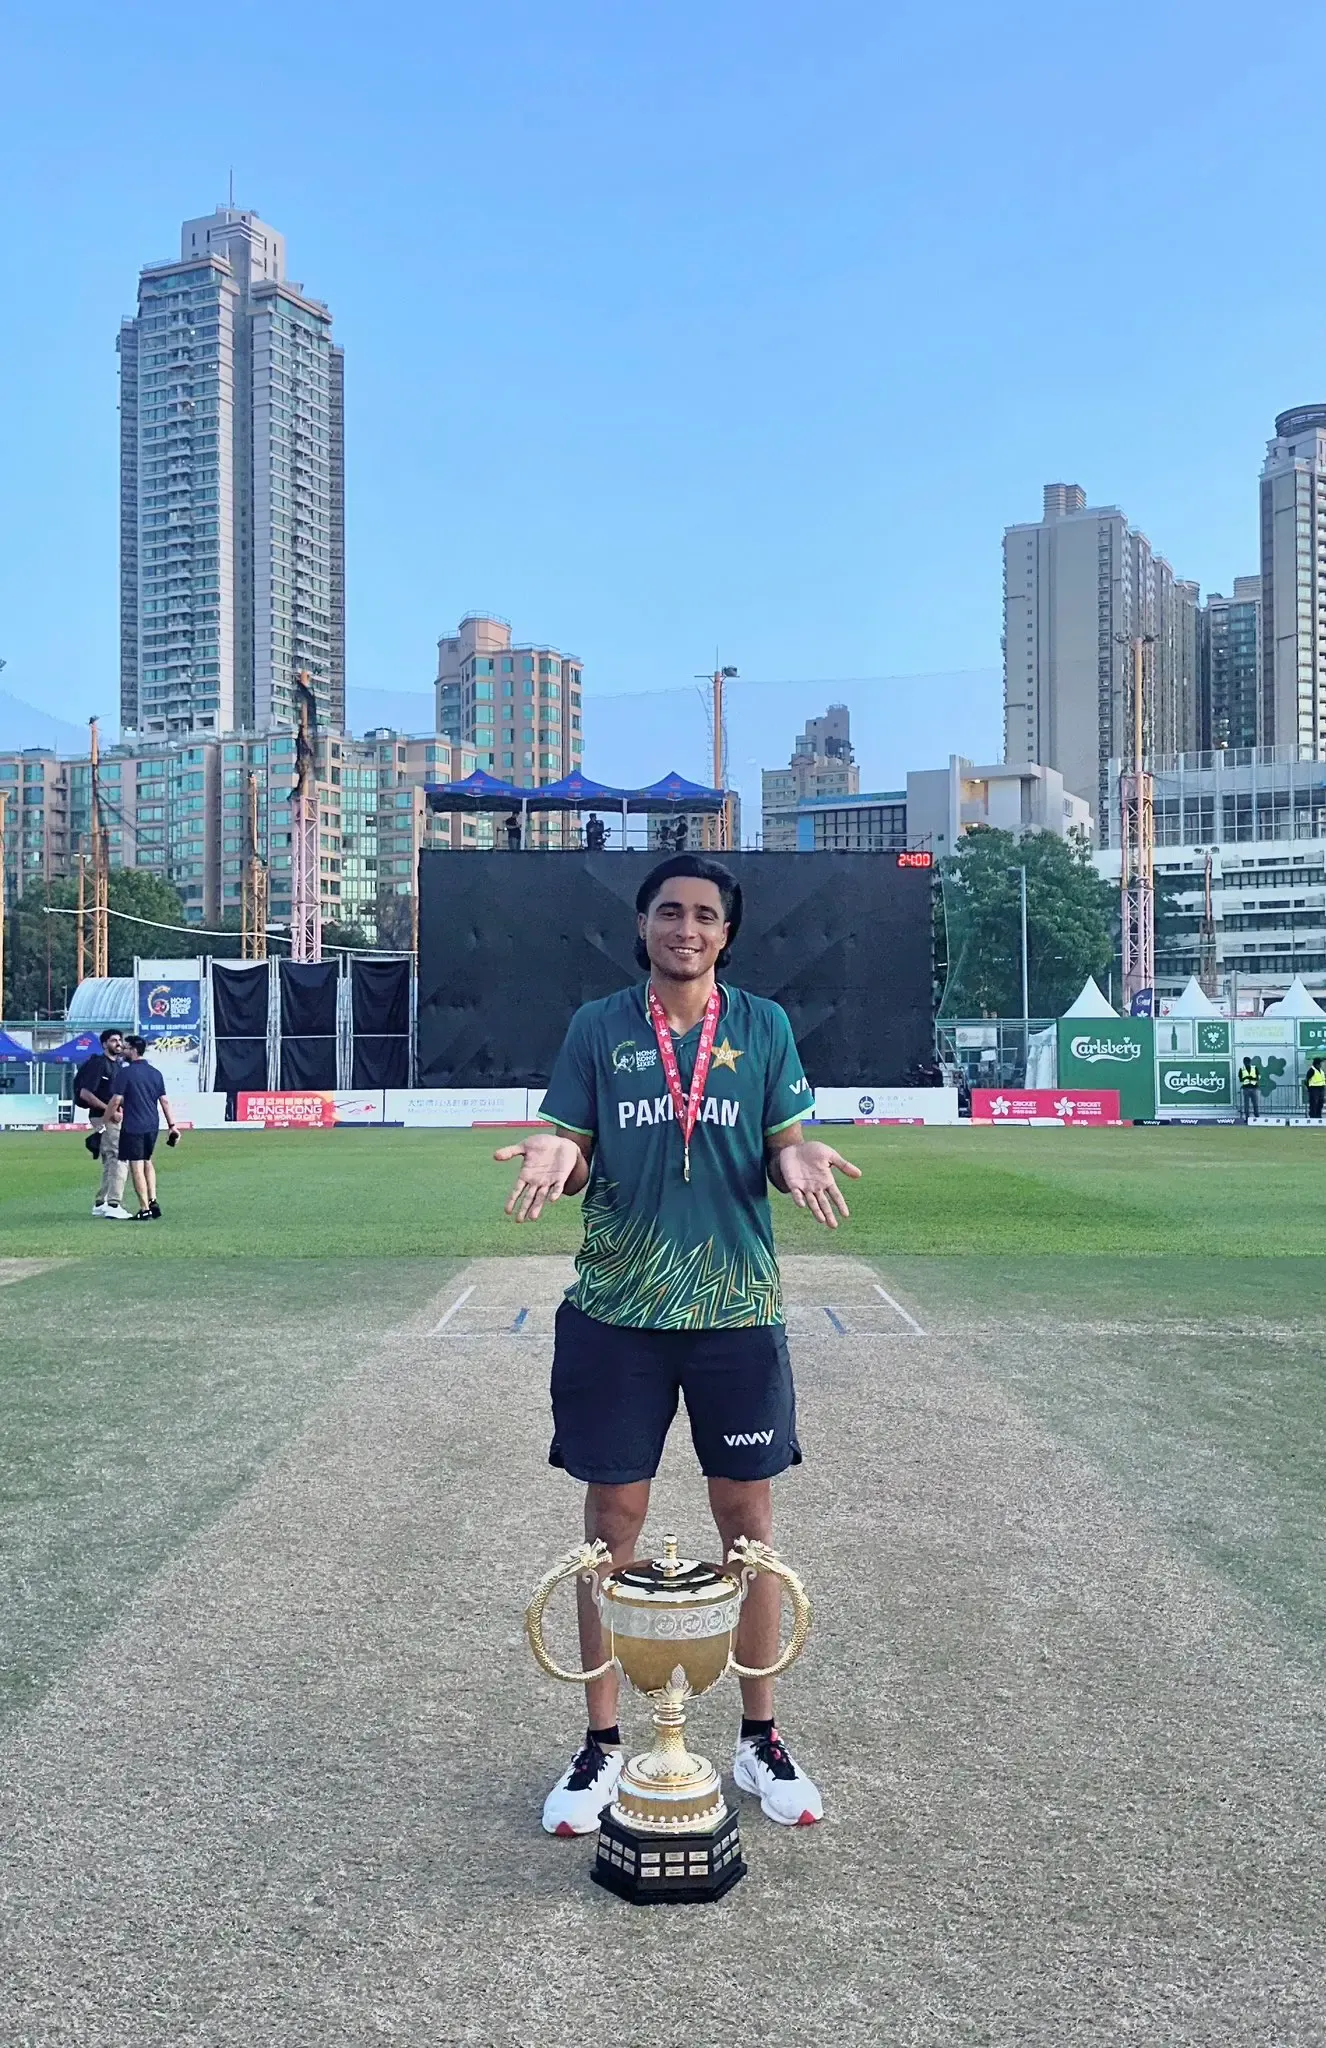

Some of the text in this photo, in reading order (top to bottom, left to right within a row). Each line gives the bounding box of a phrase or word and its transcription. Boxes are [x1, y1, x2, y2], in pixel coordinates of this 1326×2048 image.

[898, 853, 931, 867] 24:00
[1070, 1036, 1141, 1063] Carlsberg
[1164, 1071, 1225, 1094] Carlsberg
[247, 1105, 323, 1115] HONG KONG
[618, 1093, 740, 1128] PAKIAN
